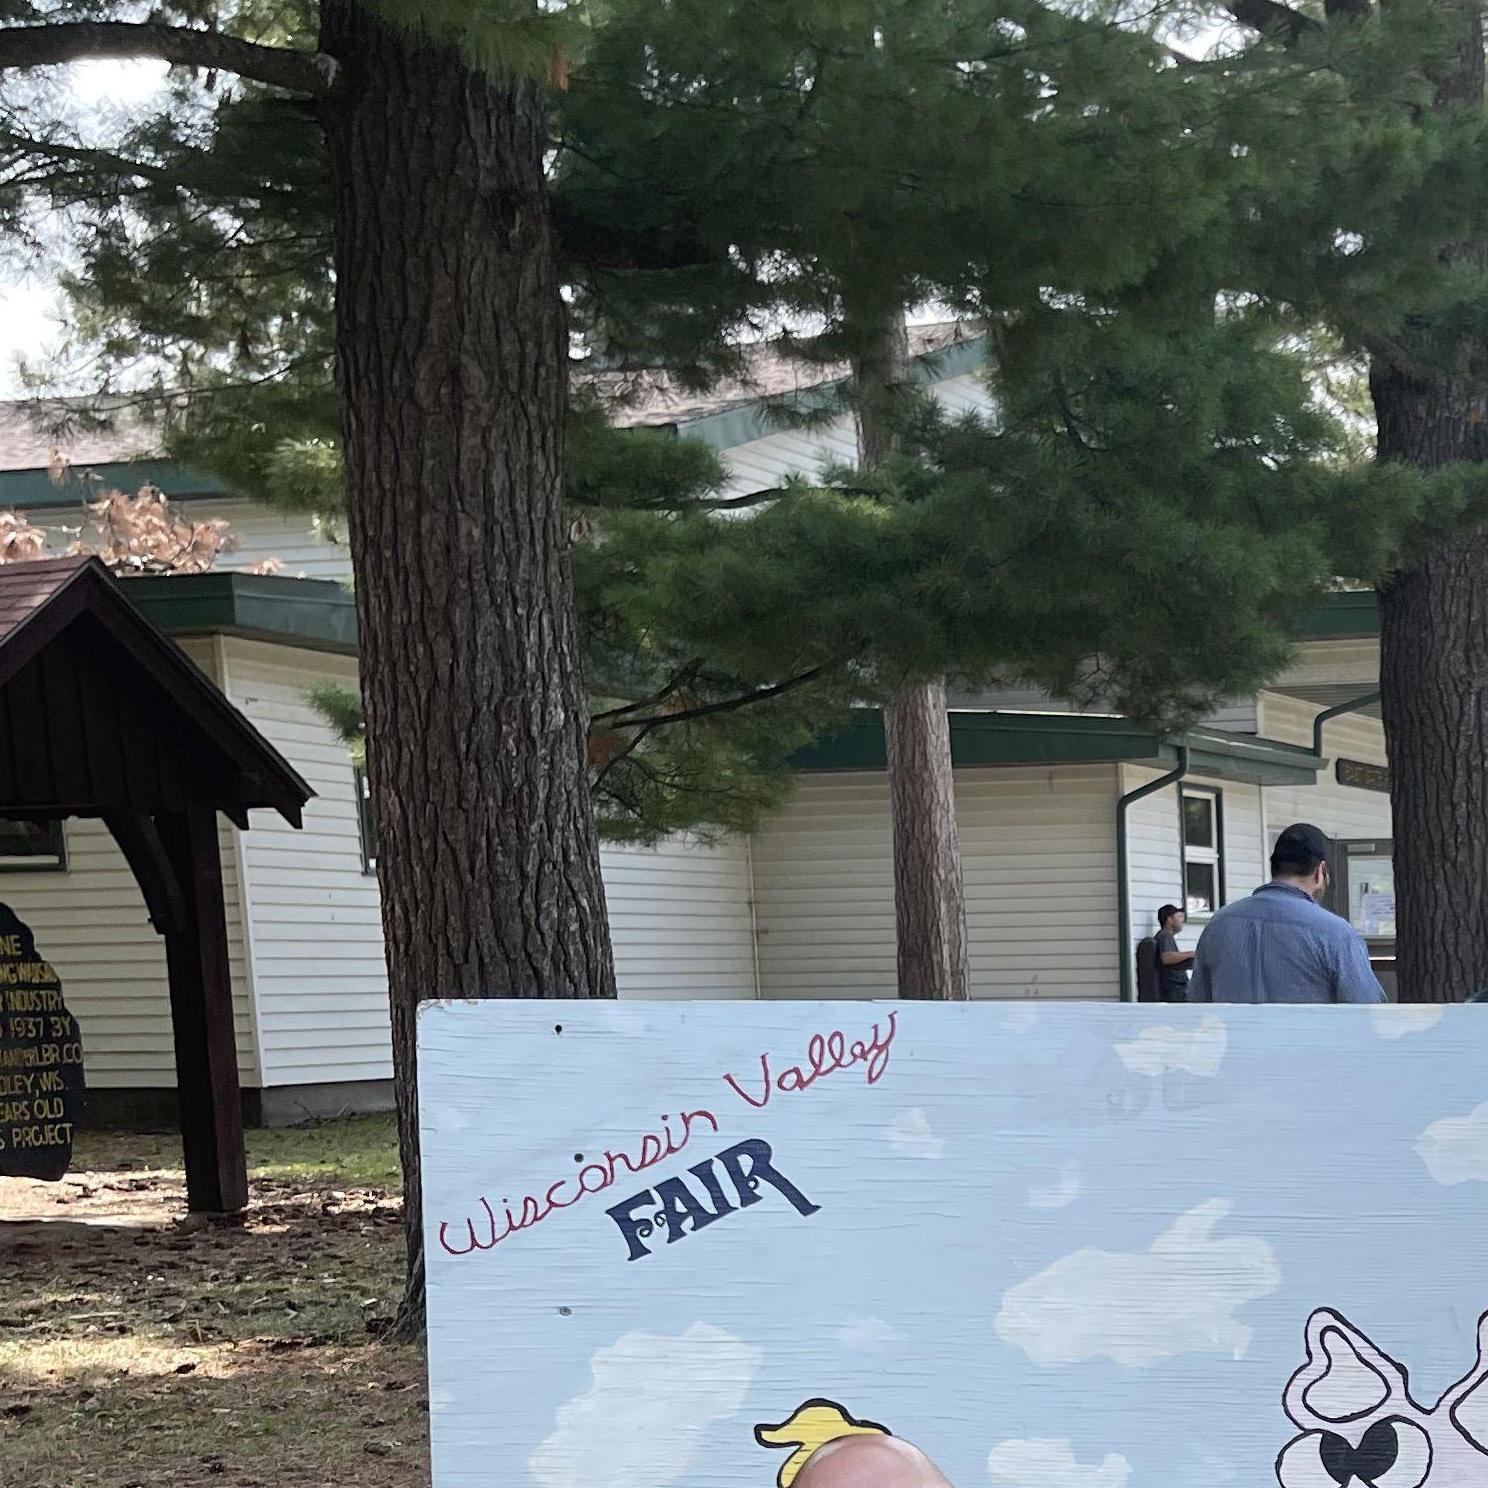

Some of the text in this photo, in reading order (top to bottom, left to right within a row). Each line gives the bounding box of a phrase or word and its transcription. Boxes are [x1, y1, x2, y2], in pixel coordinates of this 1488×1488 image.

[10, 1016, 71, 1039] 1937 BY
[33, 1097, 64, 1119] OLD
[12, 1123, 73, 1149] PROJECT
[439, 1010, 898, 1256] Wisconsin Valley
[604, 1138, 822, 1262] FAIR
